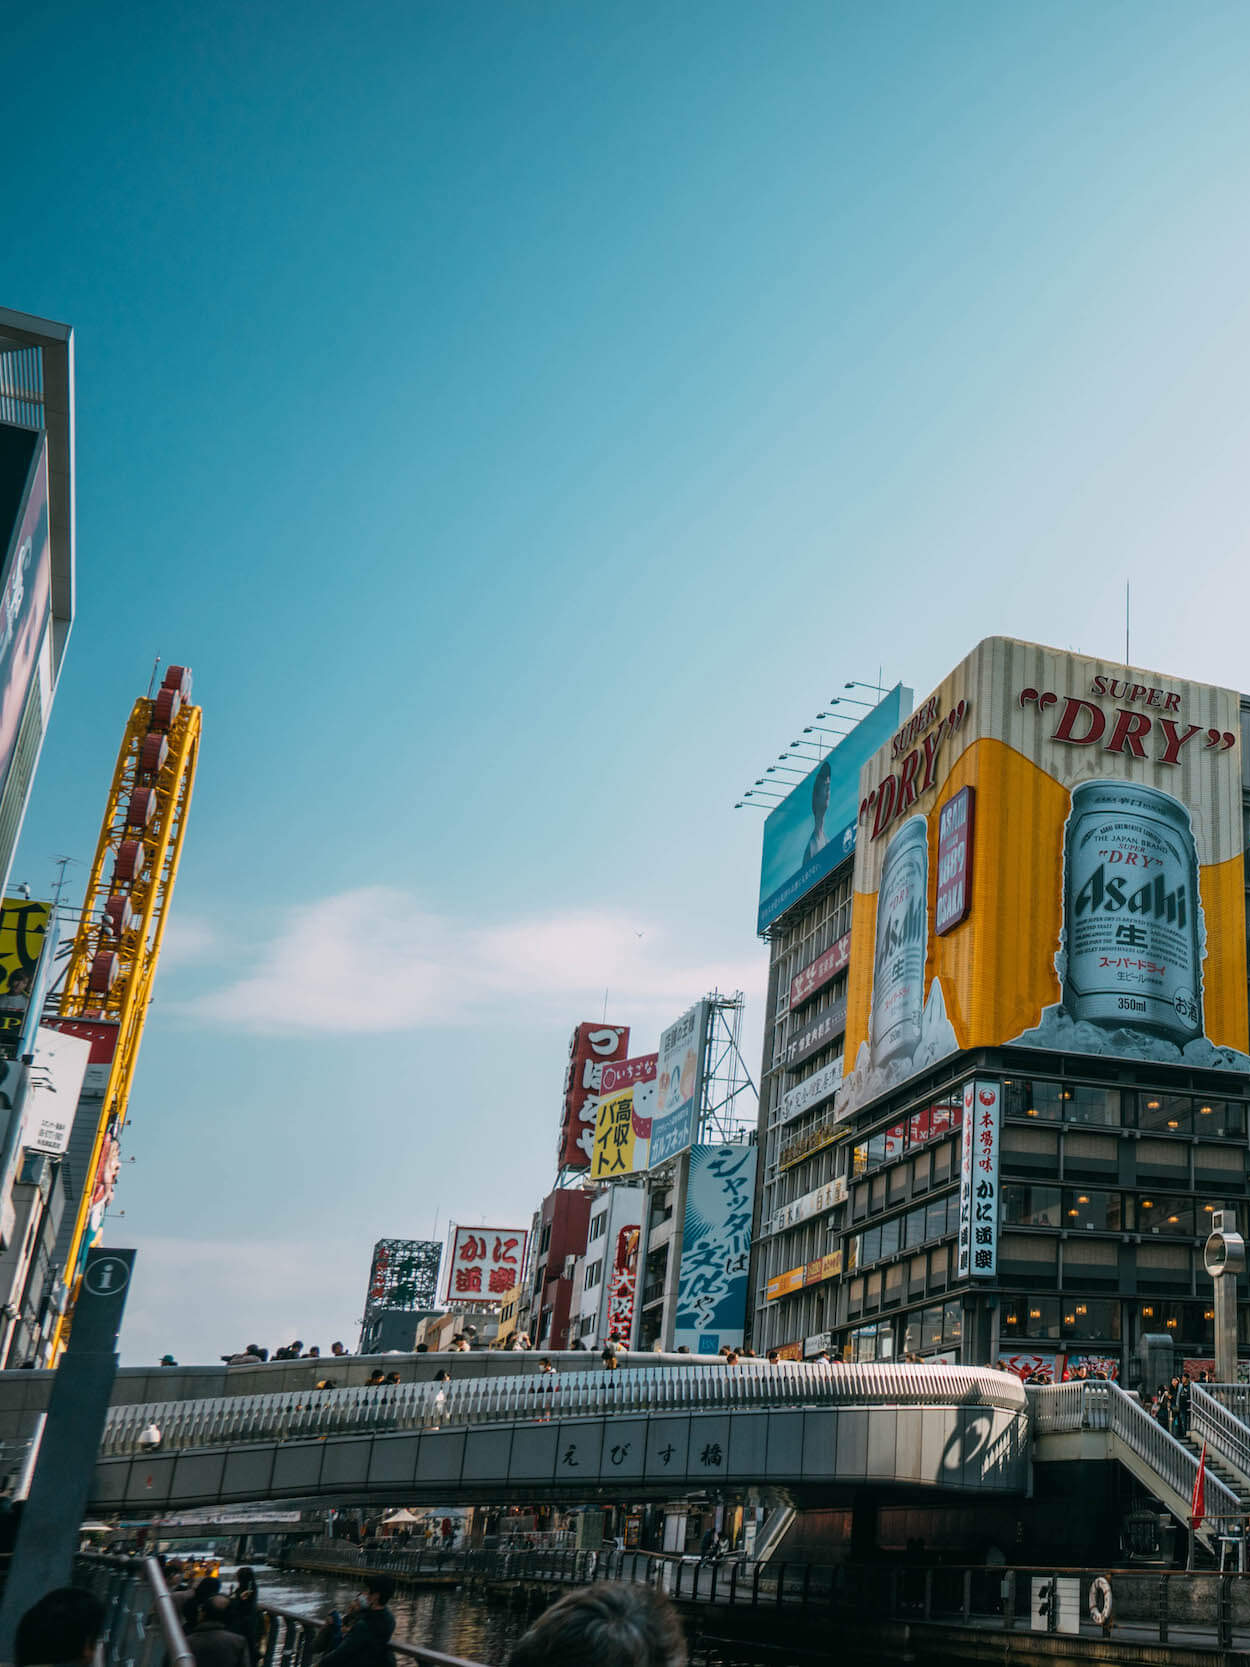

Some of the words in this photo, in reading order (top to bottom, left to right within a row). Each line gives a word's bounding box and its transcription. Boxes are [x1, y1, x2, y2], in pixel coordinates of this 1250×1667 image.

[1091, 675, 1182, 713] SUPER
[890, 696, 938, 760] SUPER
[1110, 835, 1139, 845] JAPAN
[1140, 838, 1168, 854] BRAND
[1117, 842, 1146, 853] SUPER
[1074, 863, 1187, 930] Asahi
[1115, 924, 1149, 949] 生
[1099, 957, 1166, 976] スーパードライ
[1118, 998, 1147, 1012] 350ml
[597, 1103, 618, 1175] バイト
[613, 1099, 633, 1171] 高収入
[979, 1111, 994, 1174] 本場の味
[459, 1235, 519, 1264] かに
[562, 1441, 724, 1468] えびす橋
